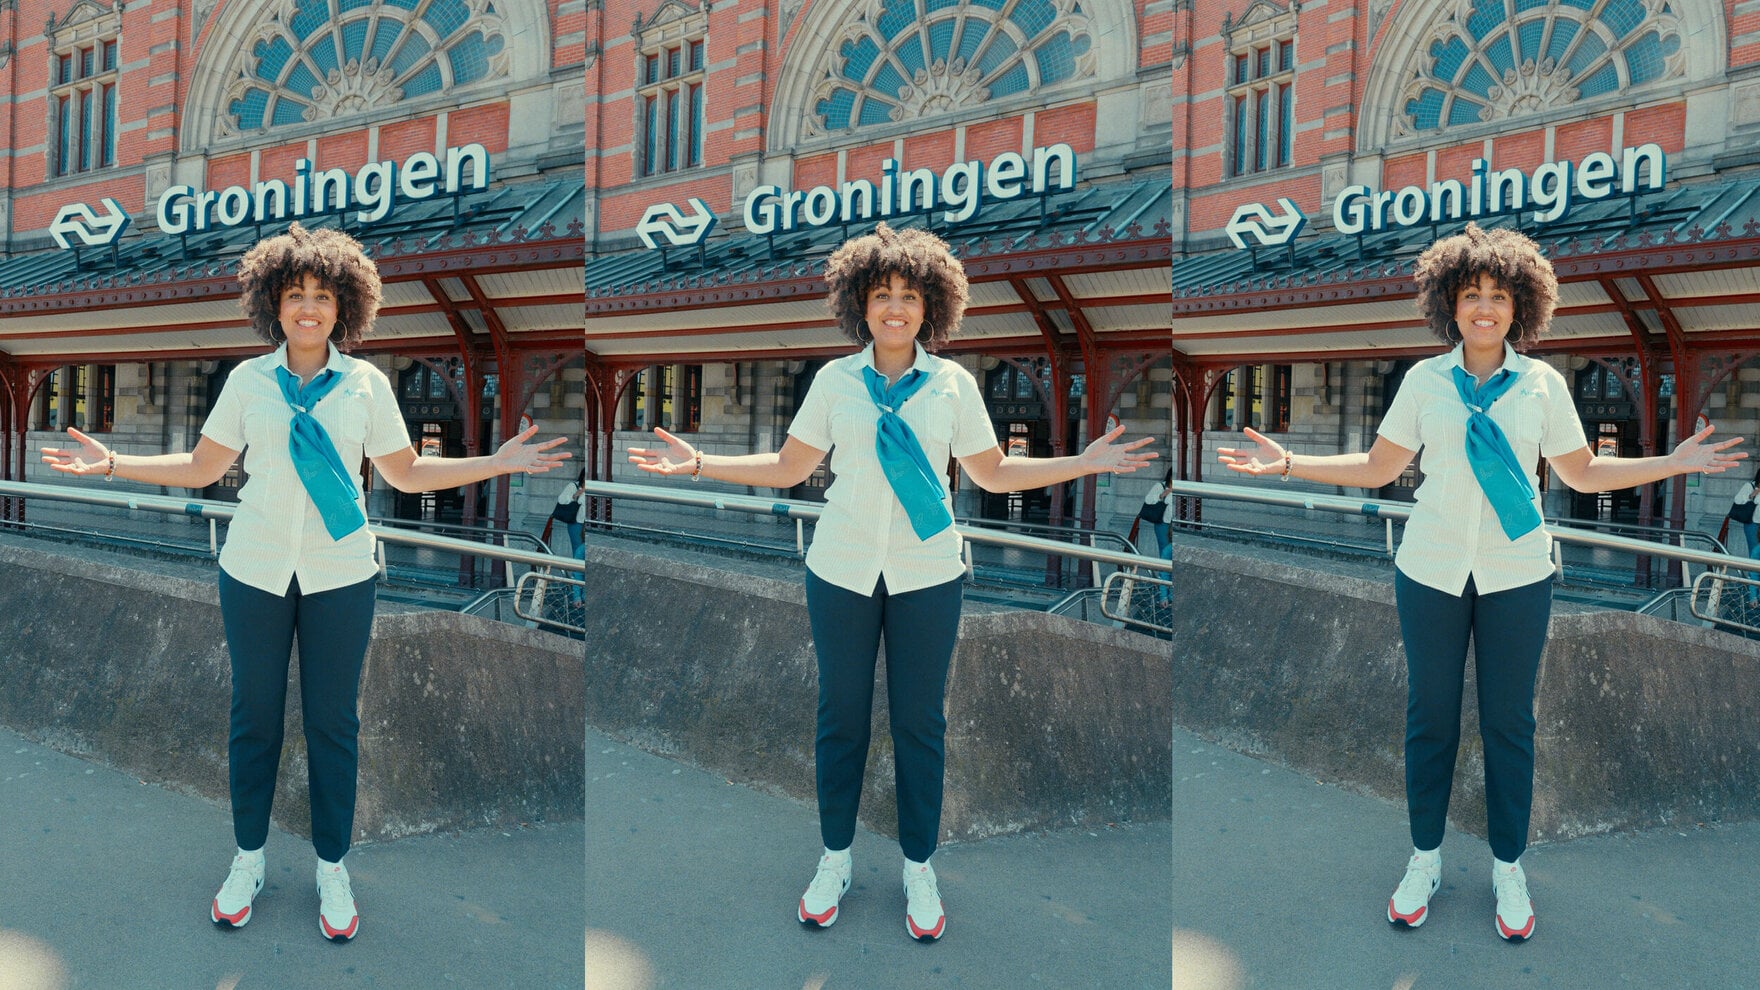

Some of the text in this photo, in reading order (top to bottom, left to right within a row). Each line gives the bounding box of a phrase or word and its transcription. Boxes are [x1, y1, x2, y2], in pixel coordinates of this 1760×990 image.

[156, 142, 490, 235] Groningen
[743, 142, 1077, 235] Groningen
[1332, 142, 1666, 235] Groningen
